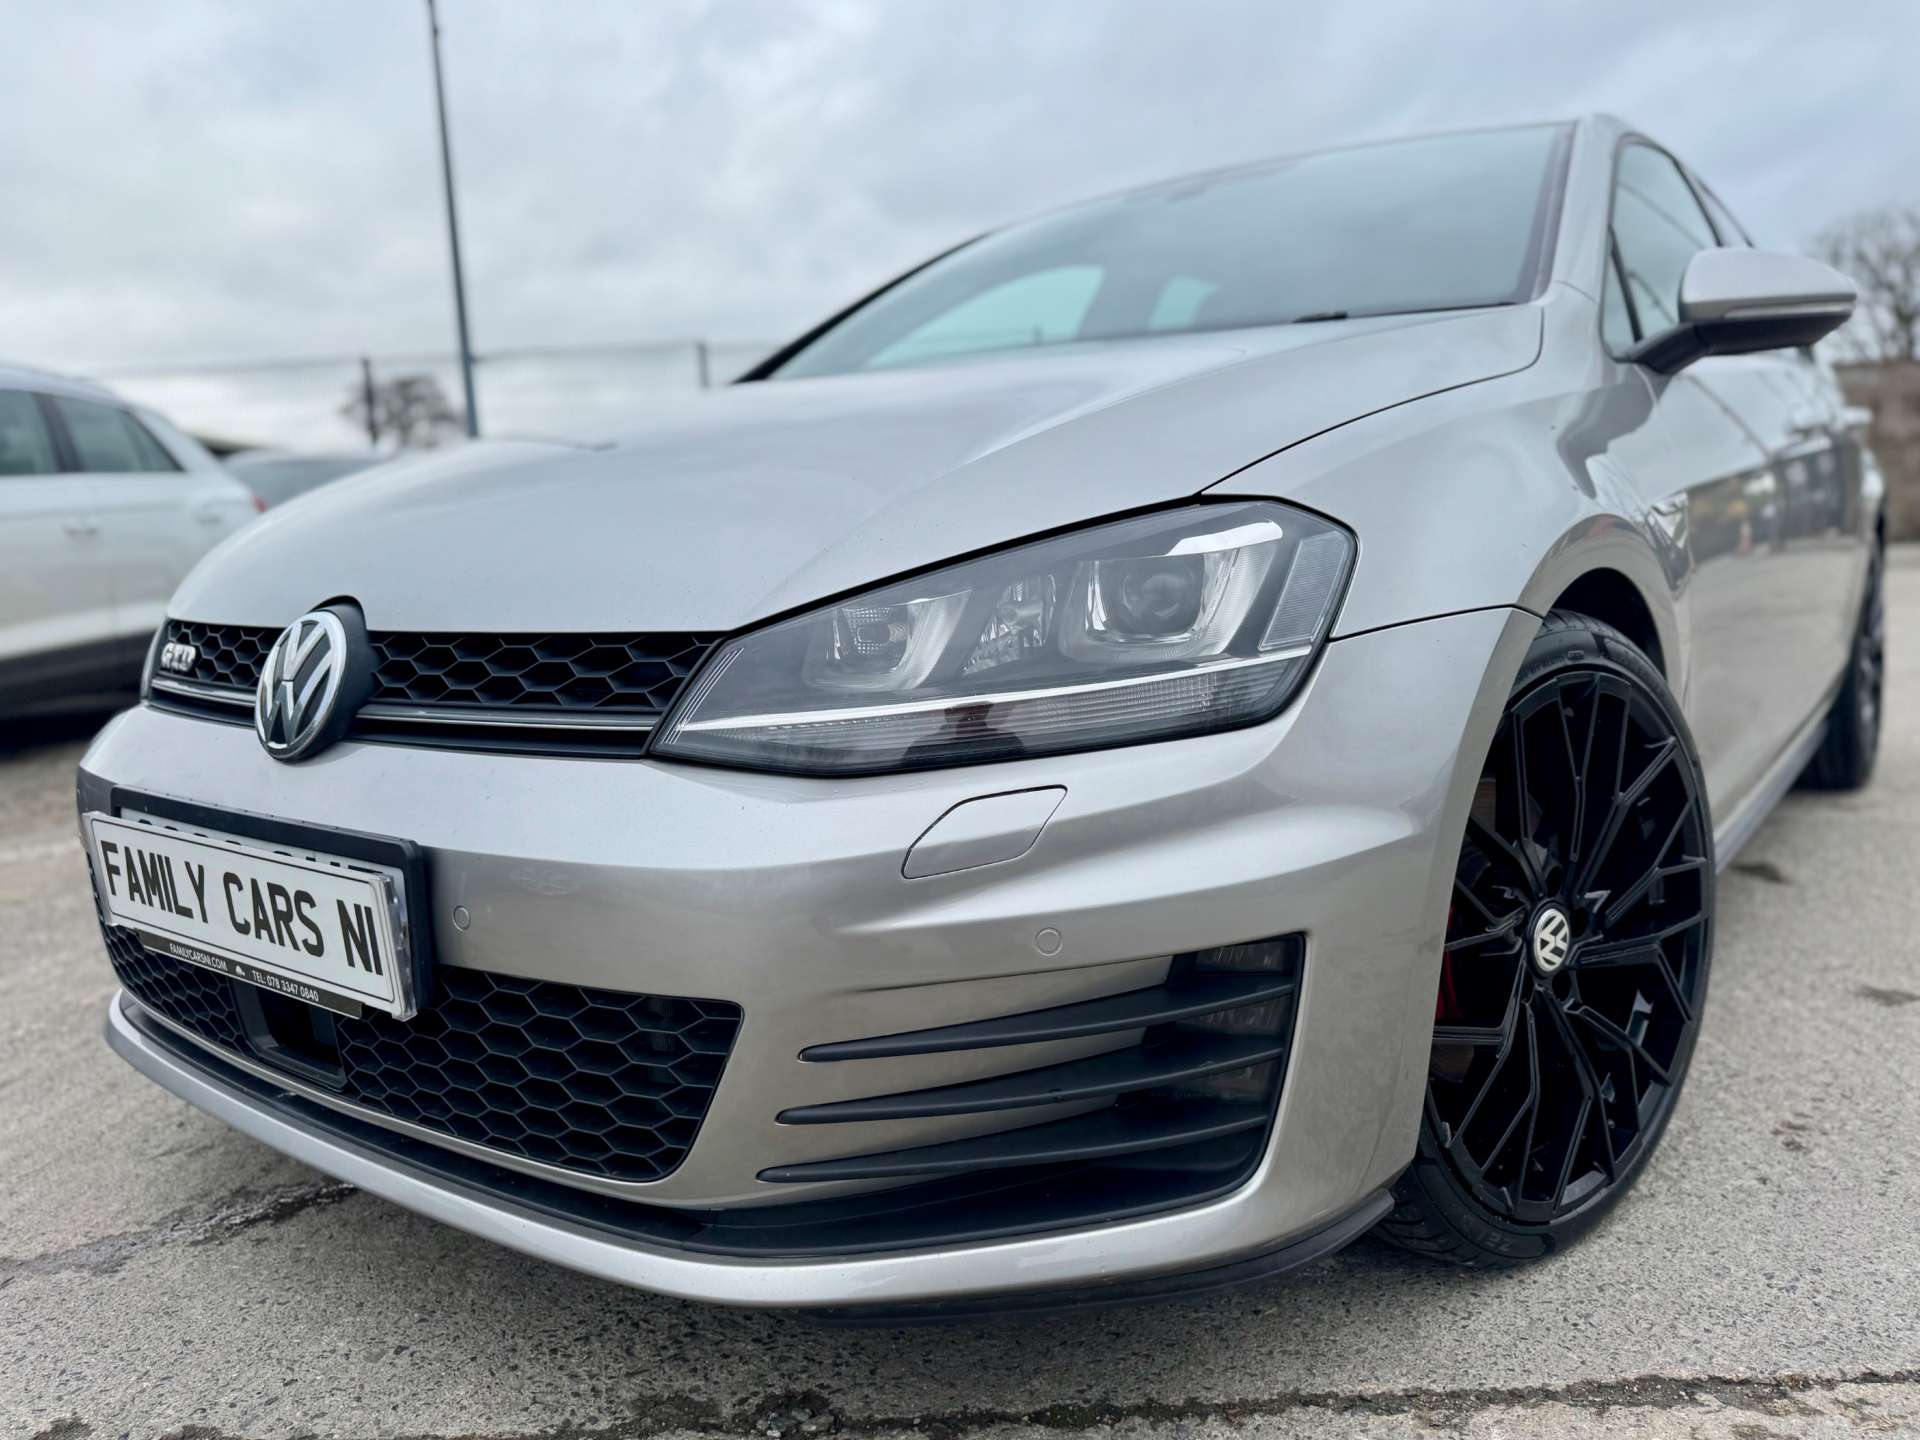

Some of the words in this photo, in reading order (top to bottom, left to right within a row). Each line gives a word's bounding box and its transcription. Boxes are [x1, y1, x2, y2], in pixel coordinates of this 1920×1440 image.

[101, 840, 208, 924] FAMILY
[222, 871, 325, 958] CARS
[336, 898, 383, 976] NI
[169, 943, 228, 972] FAMILYCARSNI.COM
[252, 970, 267, 985] TEL:
[266, 974, 281, 990] 078
[281, 979, 299, 995] 3347
[299, 984, 320, 1002] 0840
